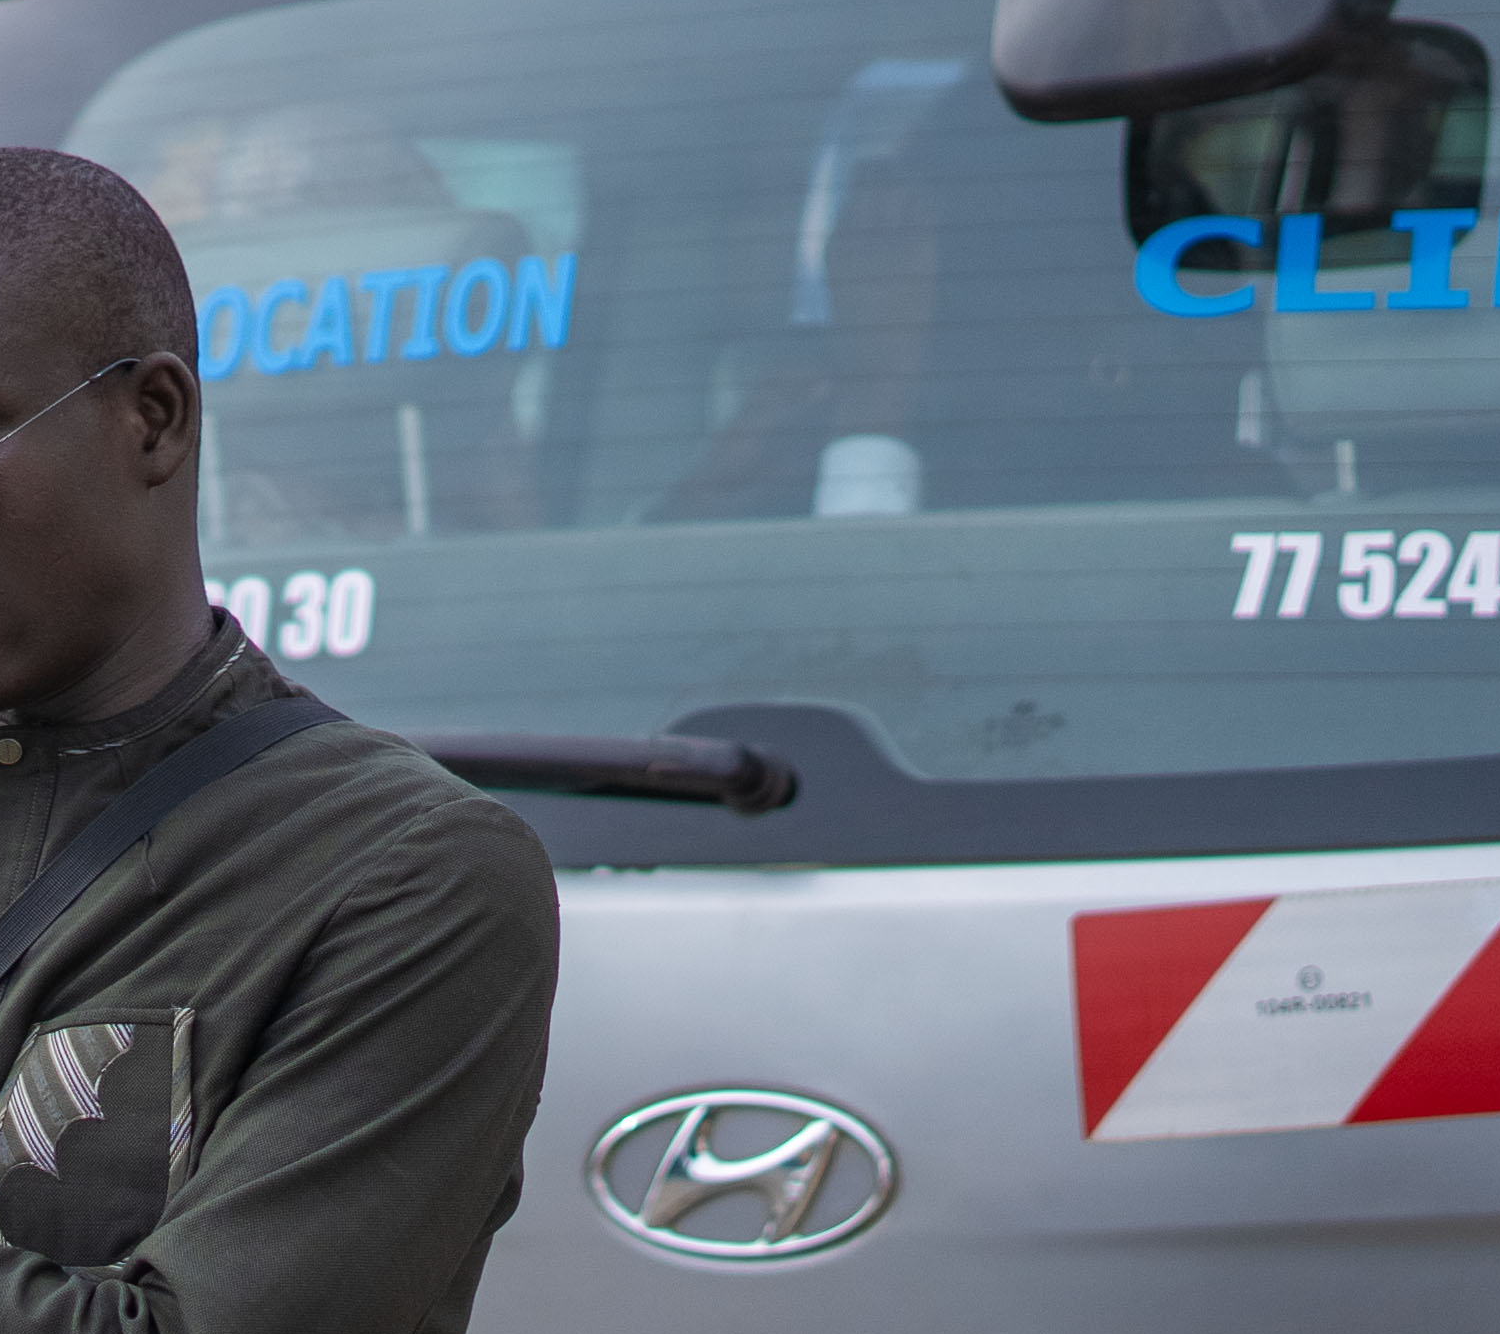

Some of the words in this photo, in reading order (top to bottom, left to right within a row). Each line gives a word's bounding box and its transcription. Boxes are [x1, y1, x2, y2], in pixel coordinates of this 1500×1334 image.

[198, 252, 579, 382] OCATION
[281, 569, 375, 659] 30
[1231, 530, 1323, 619] 77
